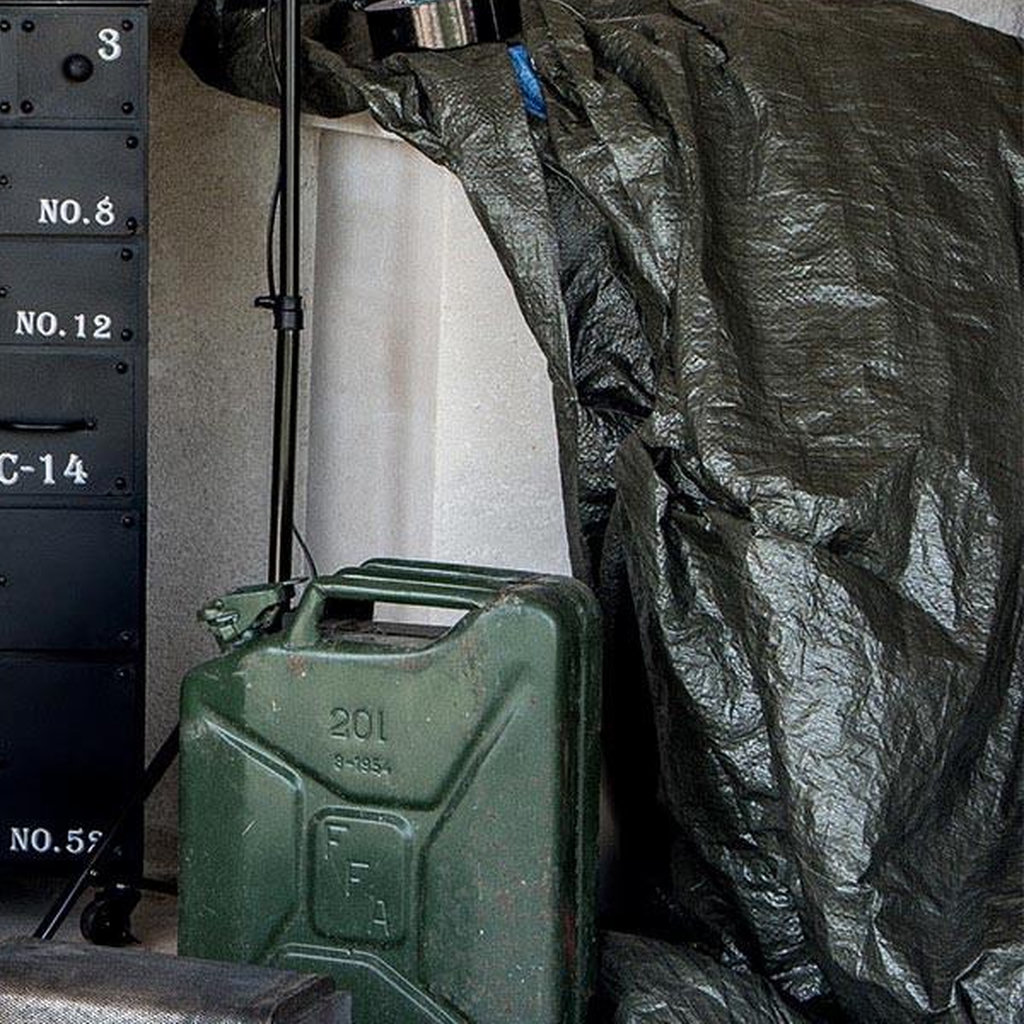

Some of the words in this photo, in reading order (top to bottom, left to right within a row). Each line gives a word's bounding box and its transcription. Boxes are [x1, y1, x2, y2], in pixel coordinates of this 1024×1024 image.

[98, 29, 122, 61] 3
[37, 196, 115, 226] NO.8
[14, 311, 112, 339] NO.12
